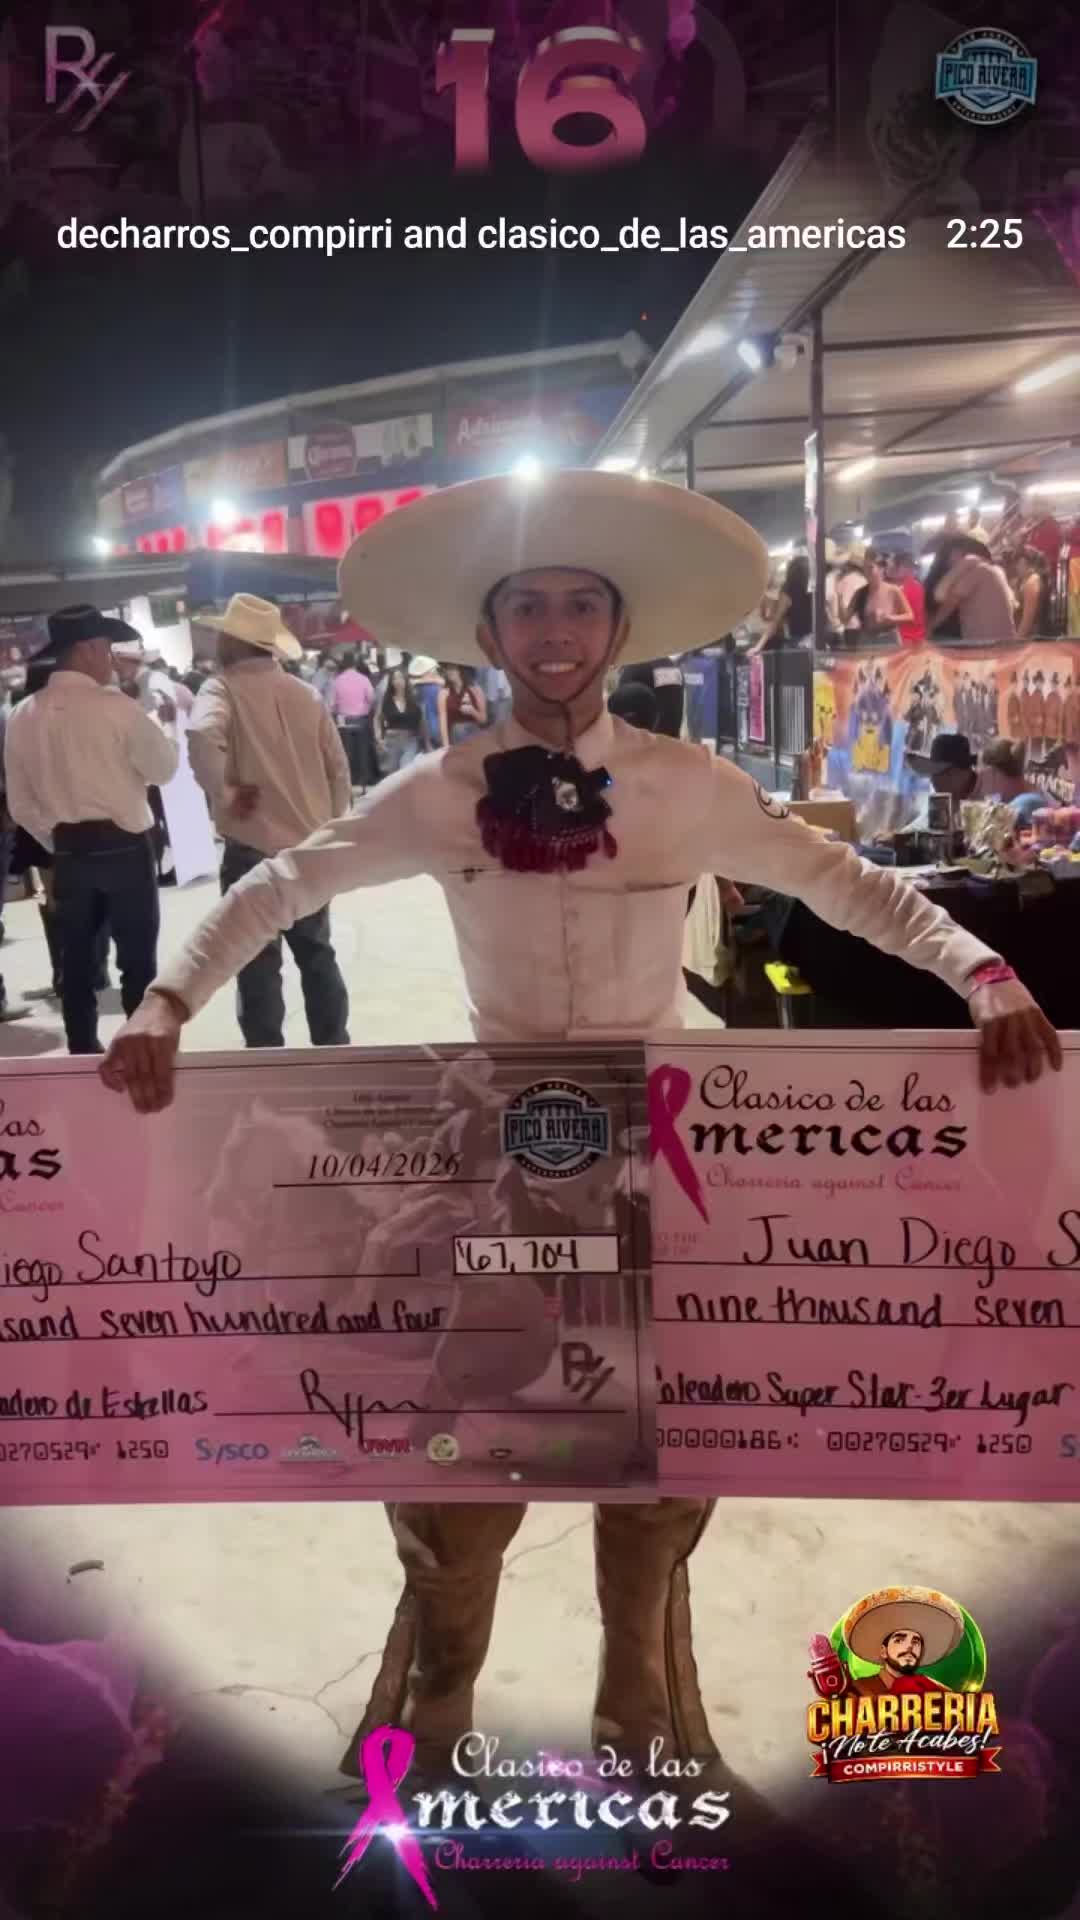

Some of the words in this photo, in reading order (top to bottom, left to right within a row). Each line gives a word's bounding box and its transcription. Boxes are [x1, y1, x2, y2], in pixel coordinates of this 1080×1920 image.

[699, 1064, 836, 1112] Clasico
[845, 1080, 884, 1112] de
[900, 1072, 956, 1113] las
[510, 1118, 541, 1145] PICO
[546, 1118, 601, 1144] RIVERA
[309, 1151, 463, 1178] 10/04/2026
[78, 1230, 241, 1297] Santoyo
[743, 1214, 869, 1267] Juan
[900, 1216, 1016, 1289] Diego
[0, 1306, 78, 1341] sand
[100, 1308, 178, 1338] seven
[184, 1301, 327, 1334] hundred
[336, 1303, 381, 1332] and
[392, 1299, 447, 1331] four
[676, 1291, 764, 1323] nine
[774, 1286, 943, 1328] thousand
[975, 1295, 1065, 1327] seven
[102, 1386, 208, 1420] Estrellas
[656, 1366, 760, 1405] oleadero
[768, 1372, 840, 1417] Super
[980, 1380, 1075, 1428] Lugar
[116, 1439, 169, 1459] 1250
[977, 1433, 1032, 1454] 1250
